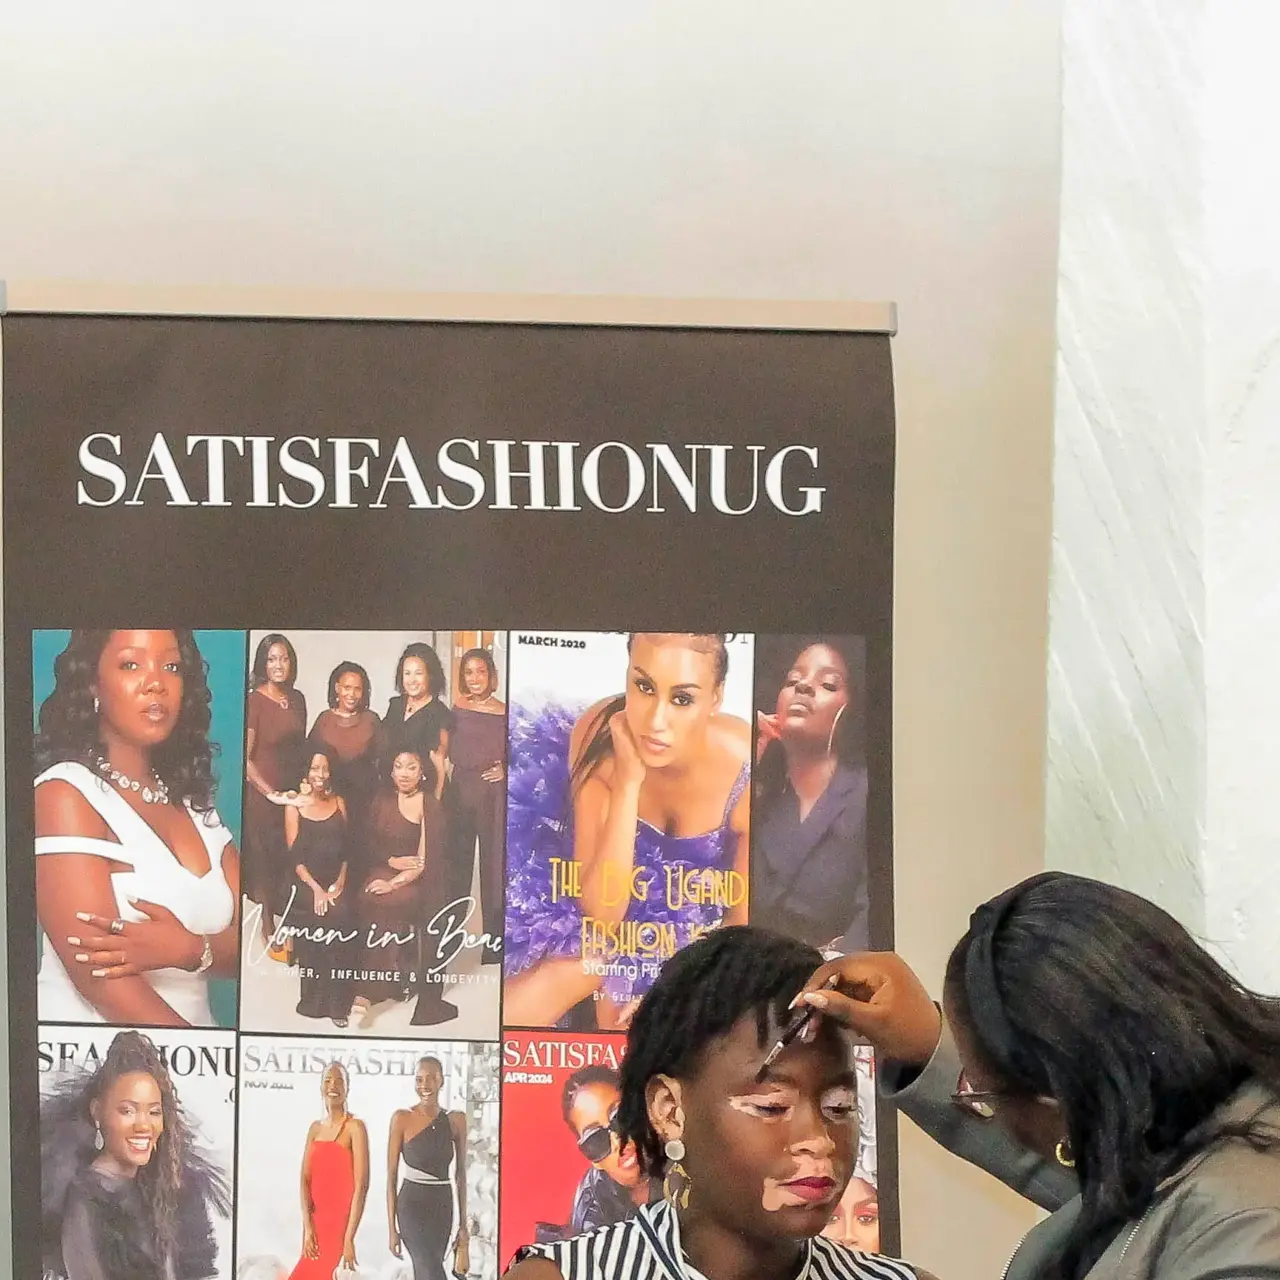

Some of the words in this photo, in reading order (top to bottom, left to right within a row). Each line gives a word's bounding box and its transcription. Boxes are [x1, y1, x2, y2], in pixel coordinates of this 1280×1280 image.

[76, 432, 826, 516] SATISFASHIONUG
[518, 635, 558, 647] MARCH
[560, 640, 586, 650] 2020
[549, 858, 583, 904] THE
[366, 923, 414, 948] in
[581, 917, 677, 961] FASHION
[331, 970, 400, 981] INFLUENCE
[409, 971, 417, 982] &
[503, 1040, 628, 1070] SATISFA
[504, 1071, 527, 1083] APR
